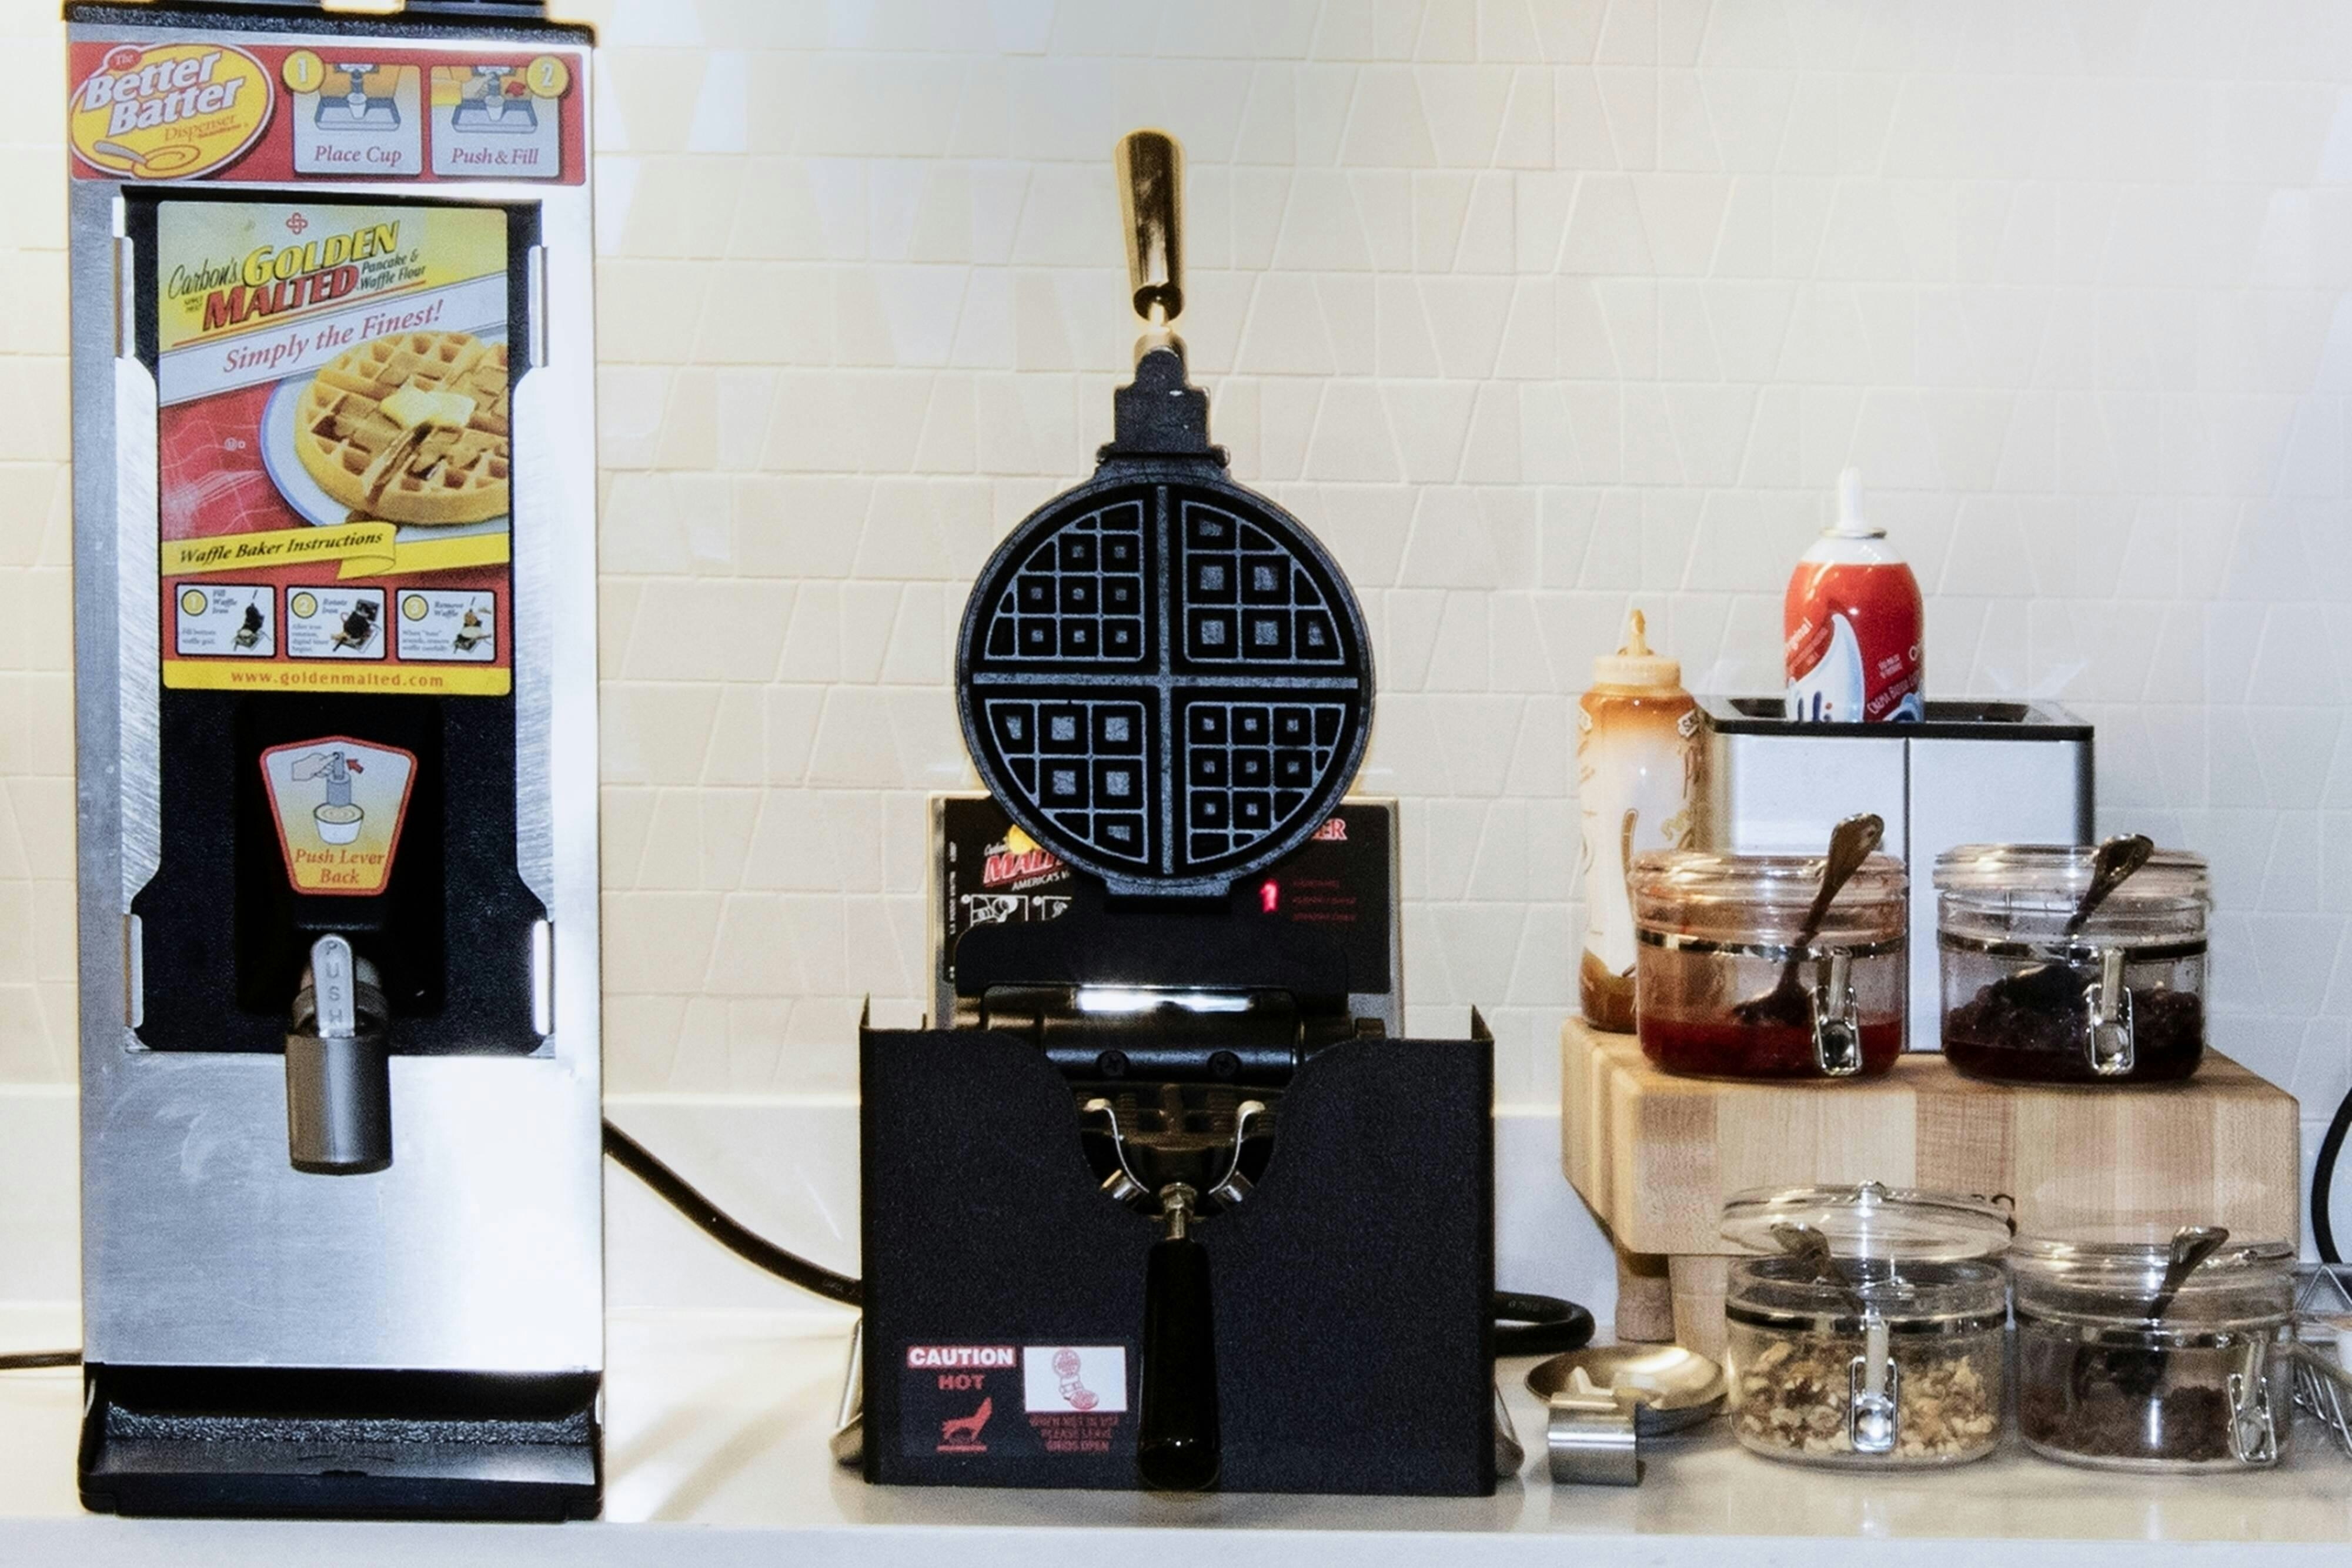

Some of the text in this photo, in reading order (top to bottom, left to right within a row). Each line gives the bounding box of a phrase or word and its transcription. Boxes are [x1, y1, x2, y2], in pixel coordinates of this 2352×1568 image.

[81, 51, 222, 113] Better
[297, 58, 308, 82] 1
[542, 62, 554, 88] 2
[106, 76, 246, 138] Batter
[165, 115, 235, 142] Dispenser
[315, 145, 402, 166] Place Cup
[451, 147, 539, 165] Push & Fill
[168, 219, 400, 299] Carbon's GOLDEN
[362, 248, 419, 275] Pancake &
[360, 265, 426, 292] Waffle Flour
[202, 265, 359, 331] MALTED
[223, 299, 444, 373] Simply the Finest!
[180, 531, 383, 566] Waffle Baker Instructions
[190, 595, 198, 609] 1
[299, 599, 309, 613] 2
[412, 600, 420, 615] 3
[231, 671, 444, 687] www.goldenmalted.com
[295, 848, 386, 865] Push Lever
[319, 868, 360, 884] Back
[324, 942, 344, 1024] PUSH
[909, 1348, 1014, 1366] CAUTION
[937, 1374, 985, 1390] HOT
